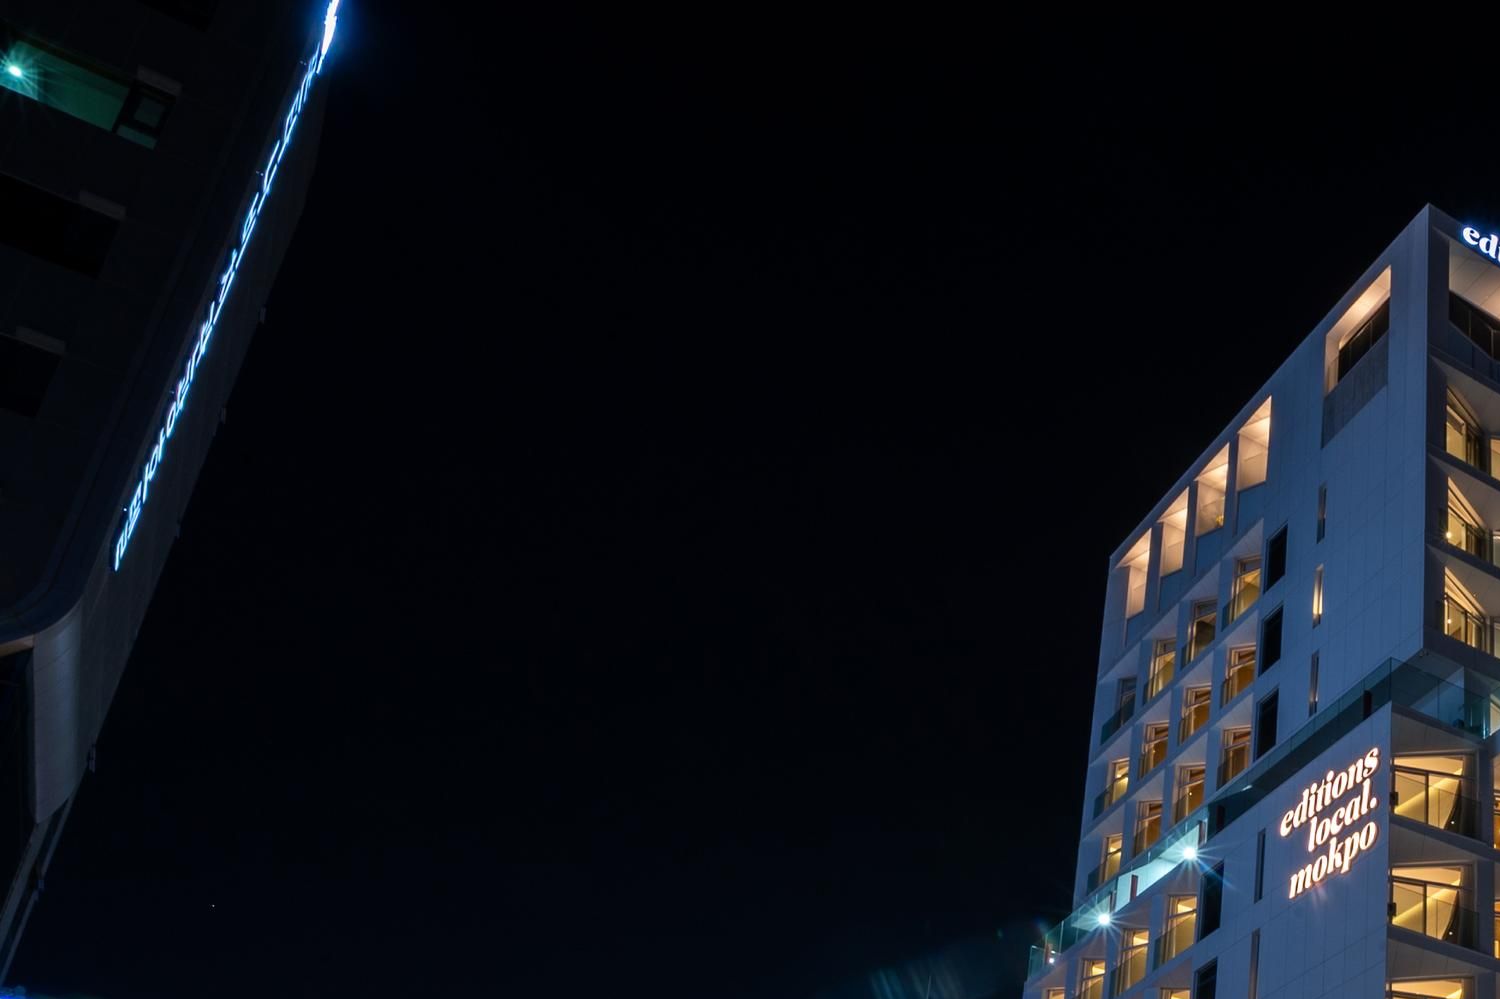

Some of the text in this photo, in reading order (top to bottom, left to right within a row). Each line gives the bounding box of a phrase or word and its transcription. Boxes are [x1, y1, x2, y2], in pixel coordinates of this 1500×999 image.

[1280, 747, 1380, 837] editions
[1308, 778, 1378, 853] local.
[1288, 821, 1377, 899] mokpo
